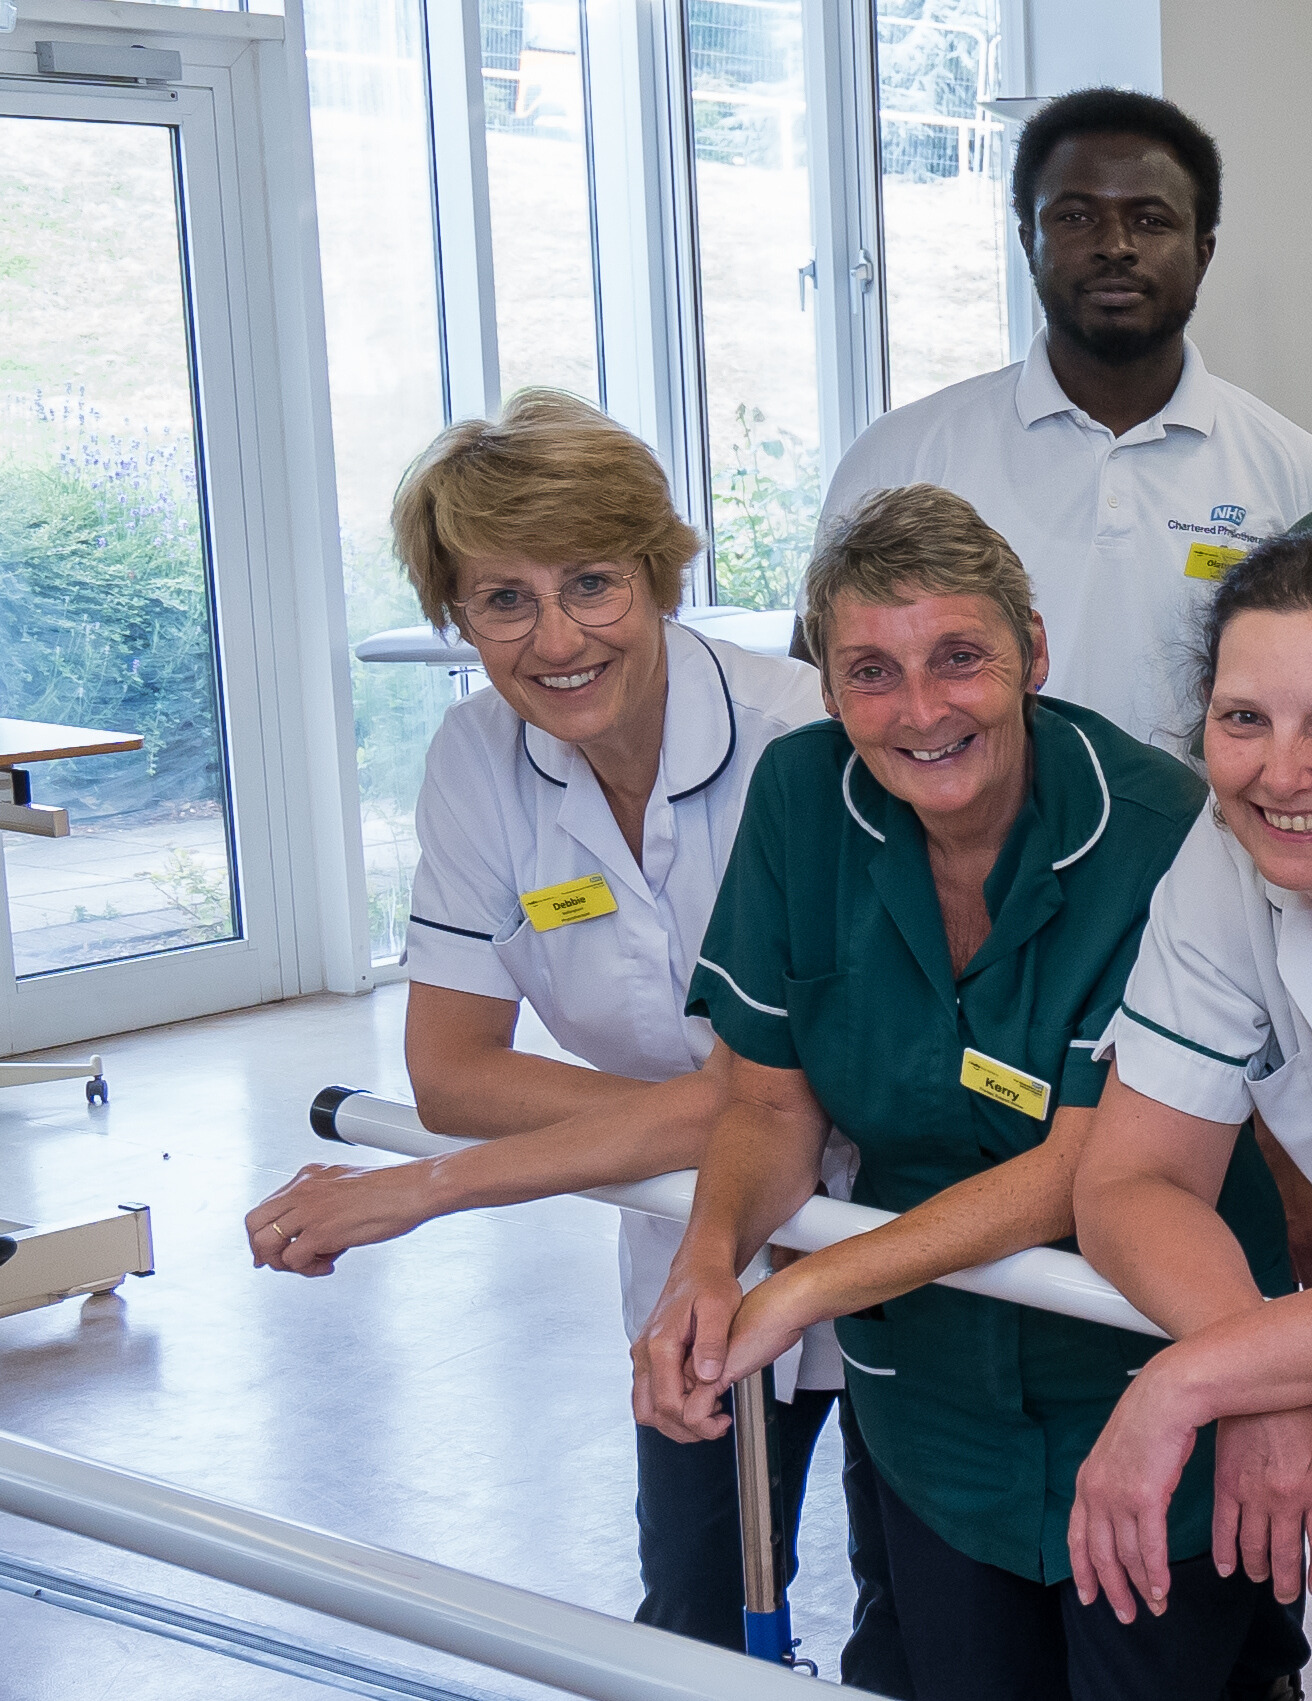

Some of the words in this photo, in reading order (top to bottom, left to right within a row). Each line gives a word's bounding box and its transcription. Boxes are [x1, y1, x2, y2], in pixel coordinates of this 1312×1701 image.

[1212, 506, 1246, 525] NHS
[1167, 519, 1217, 535] Chartered
[552, 896, 587, 911] Debbie
[986, 1077, 1020, 1102] Kerry
